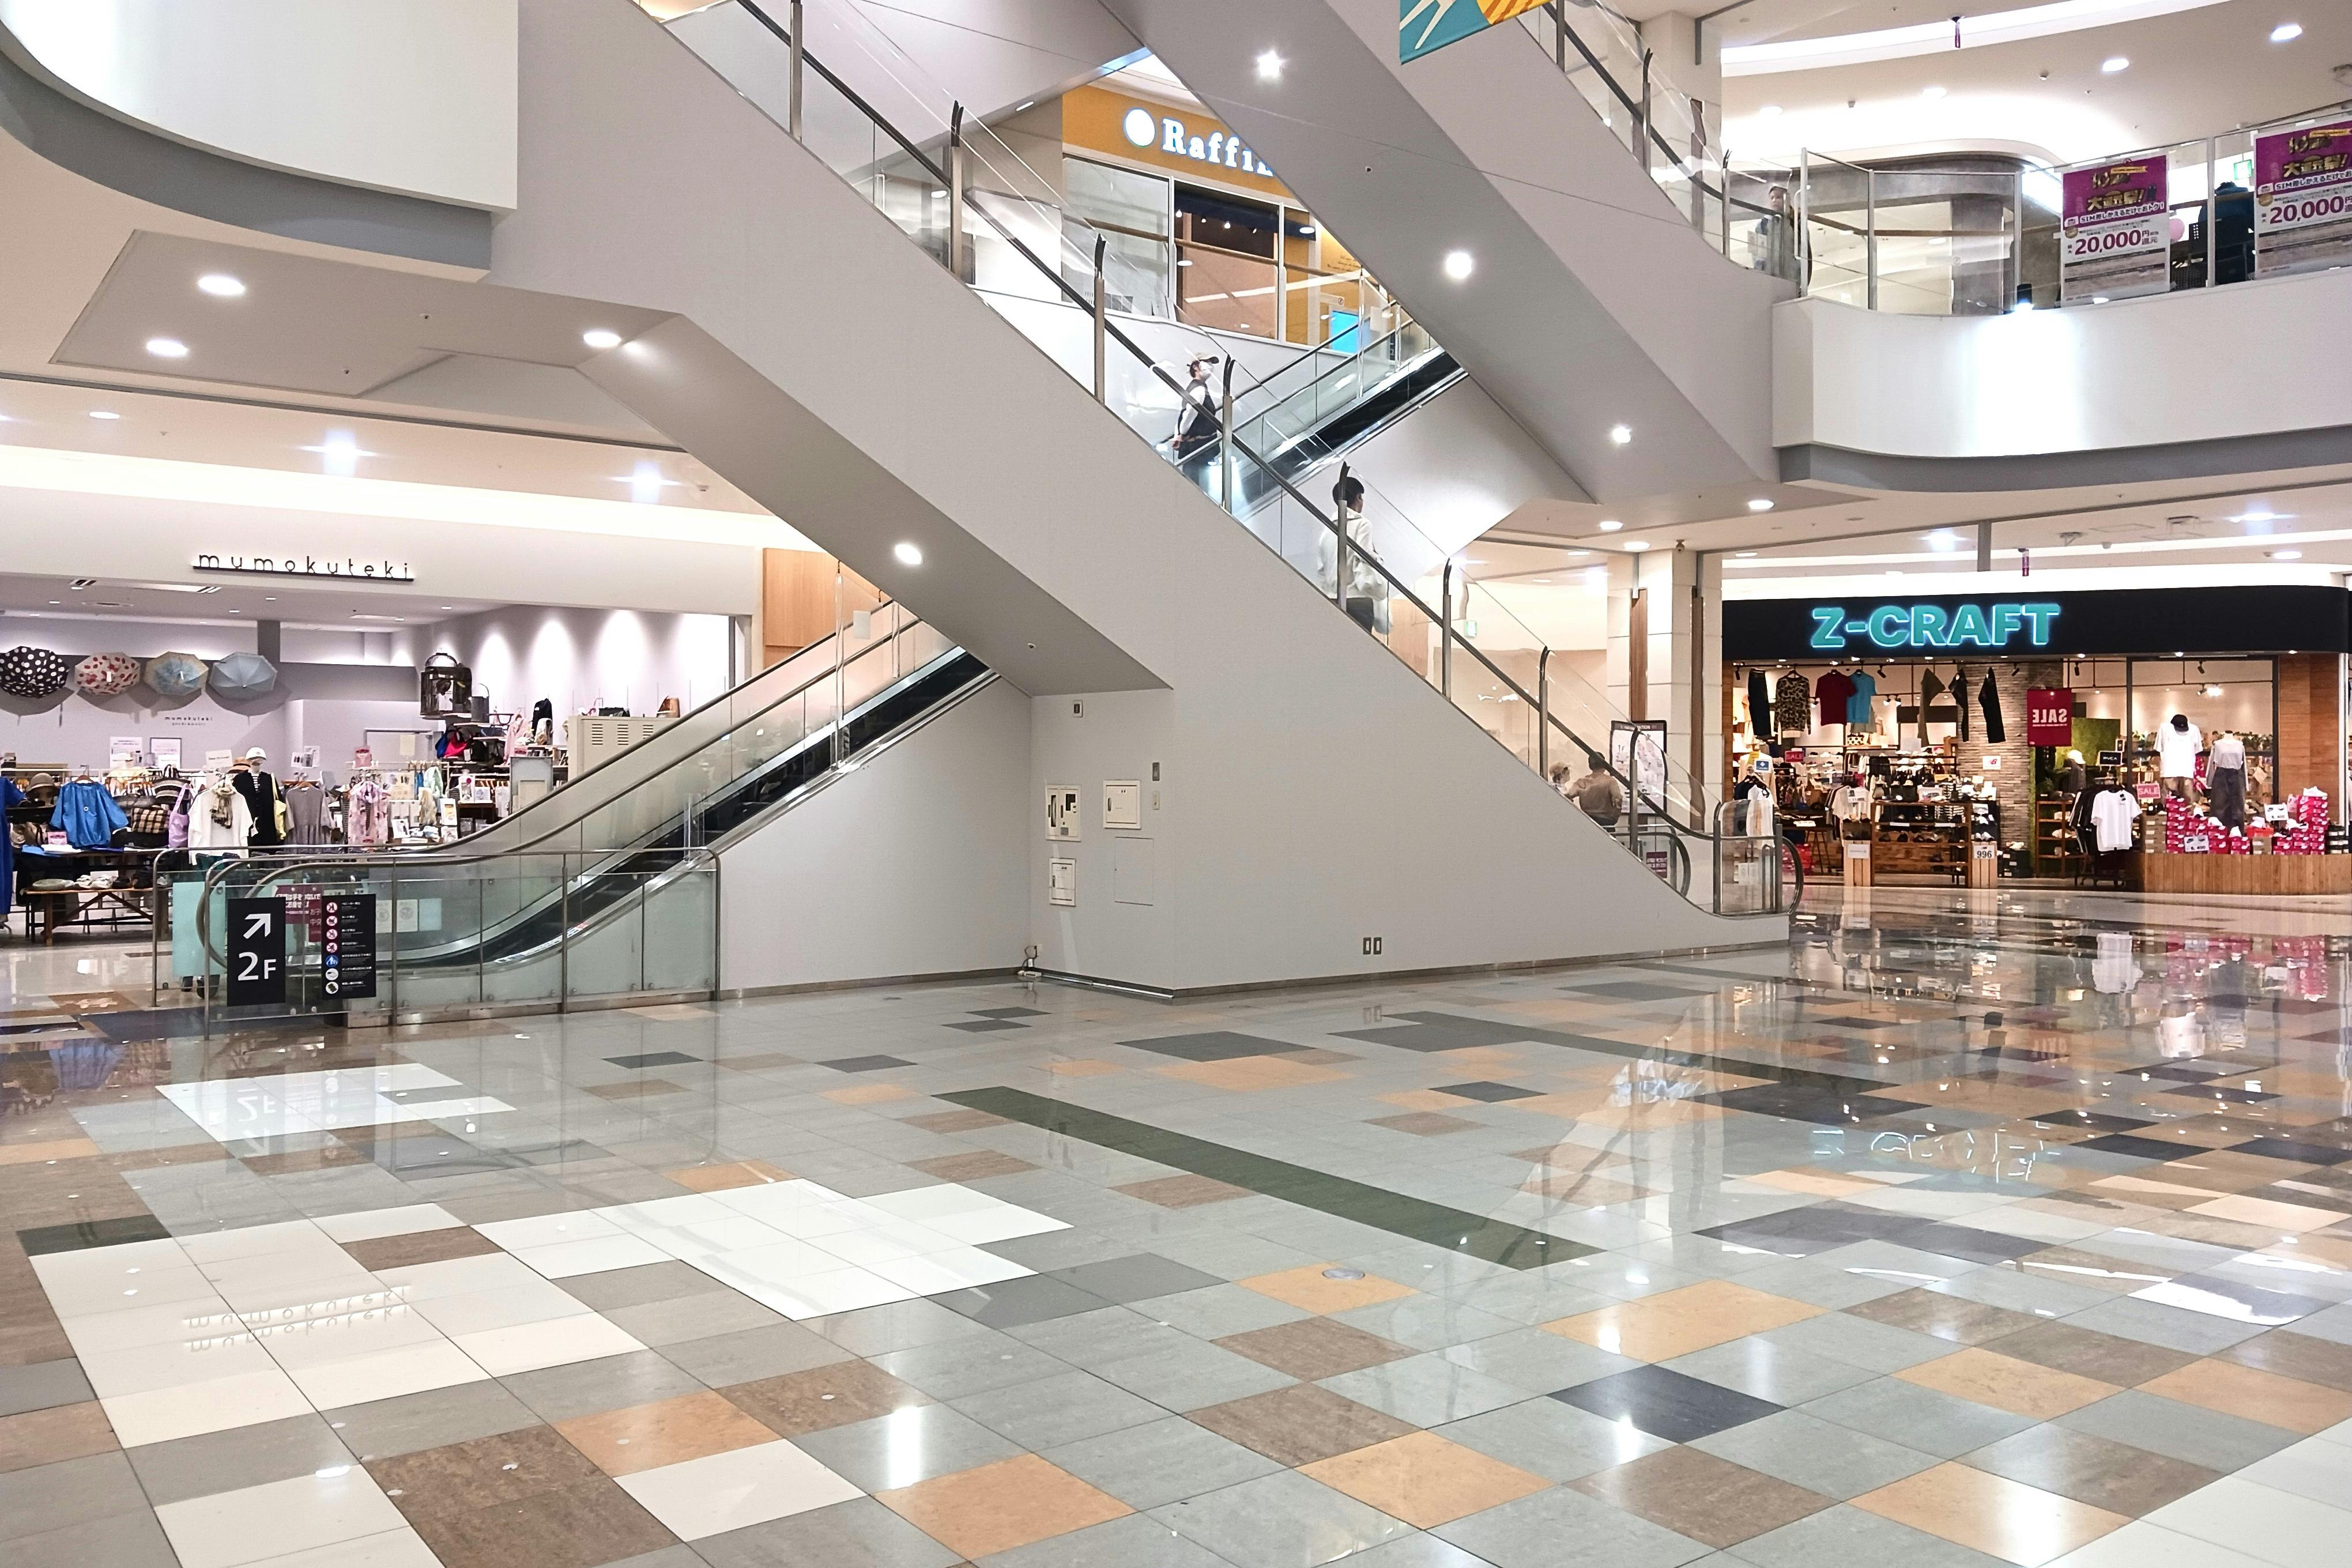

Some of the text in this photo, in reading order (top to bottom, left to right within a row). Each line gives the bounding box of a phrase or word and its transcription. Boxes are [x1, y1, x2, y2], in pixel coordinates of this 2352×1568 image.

[2270, 195, 2344, 224] 20,000
[2075, 229, 2141, 255] 20,000
[199, 555, 408, 579] mumokuteki
[1811, 604, 2061, 648] Z-CRAFT
[1977, 850, 1992, 858] 996
[238, 952, 277, 981] 2F
